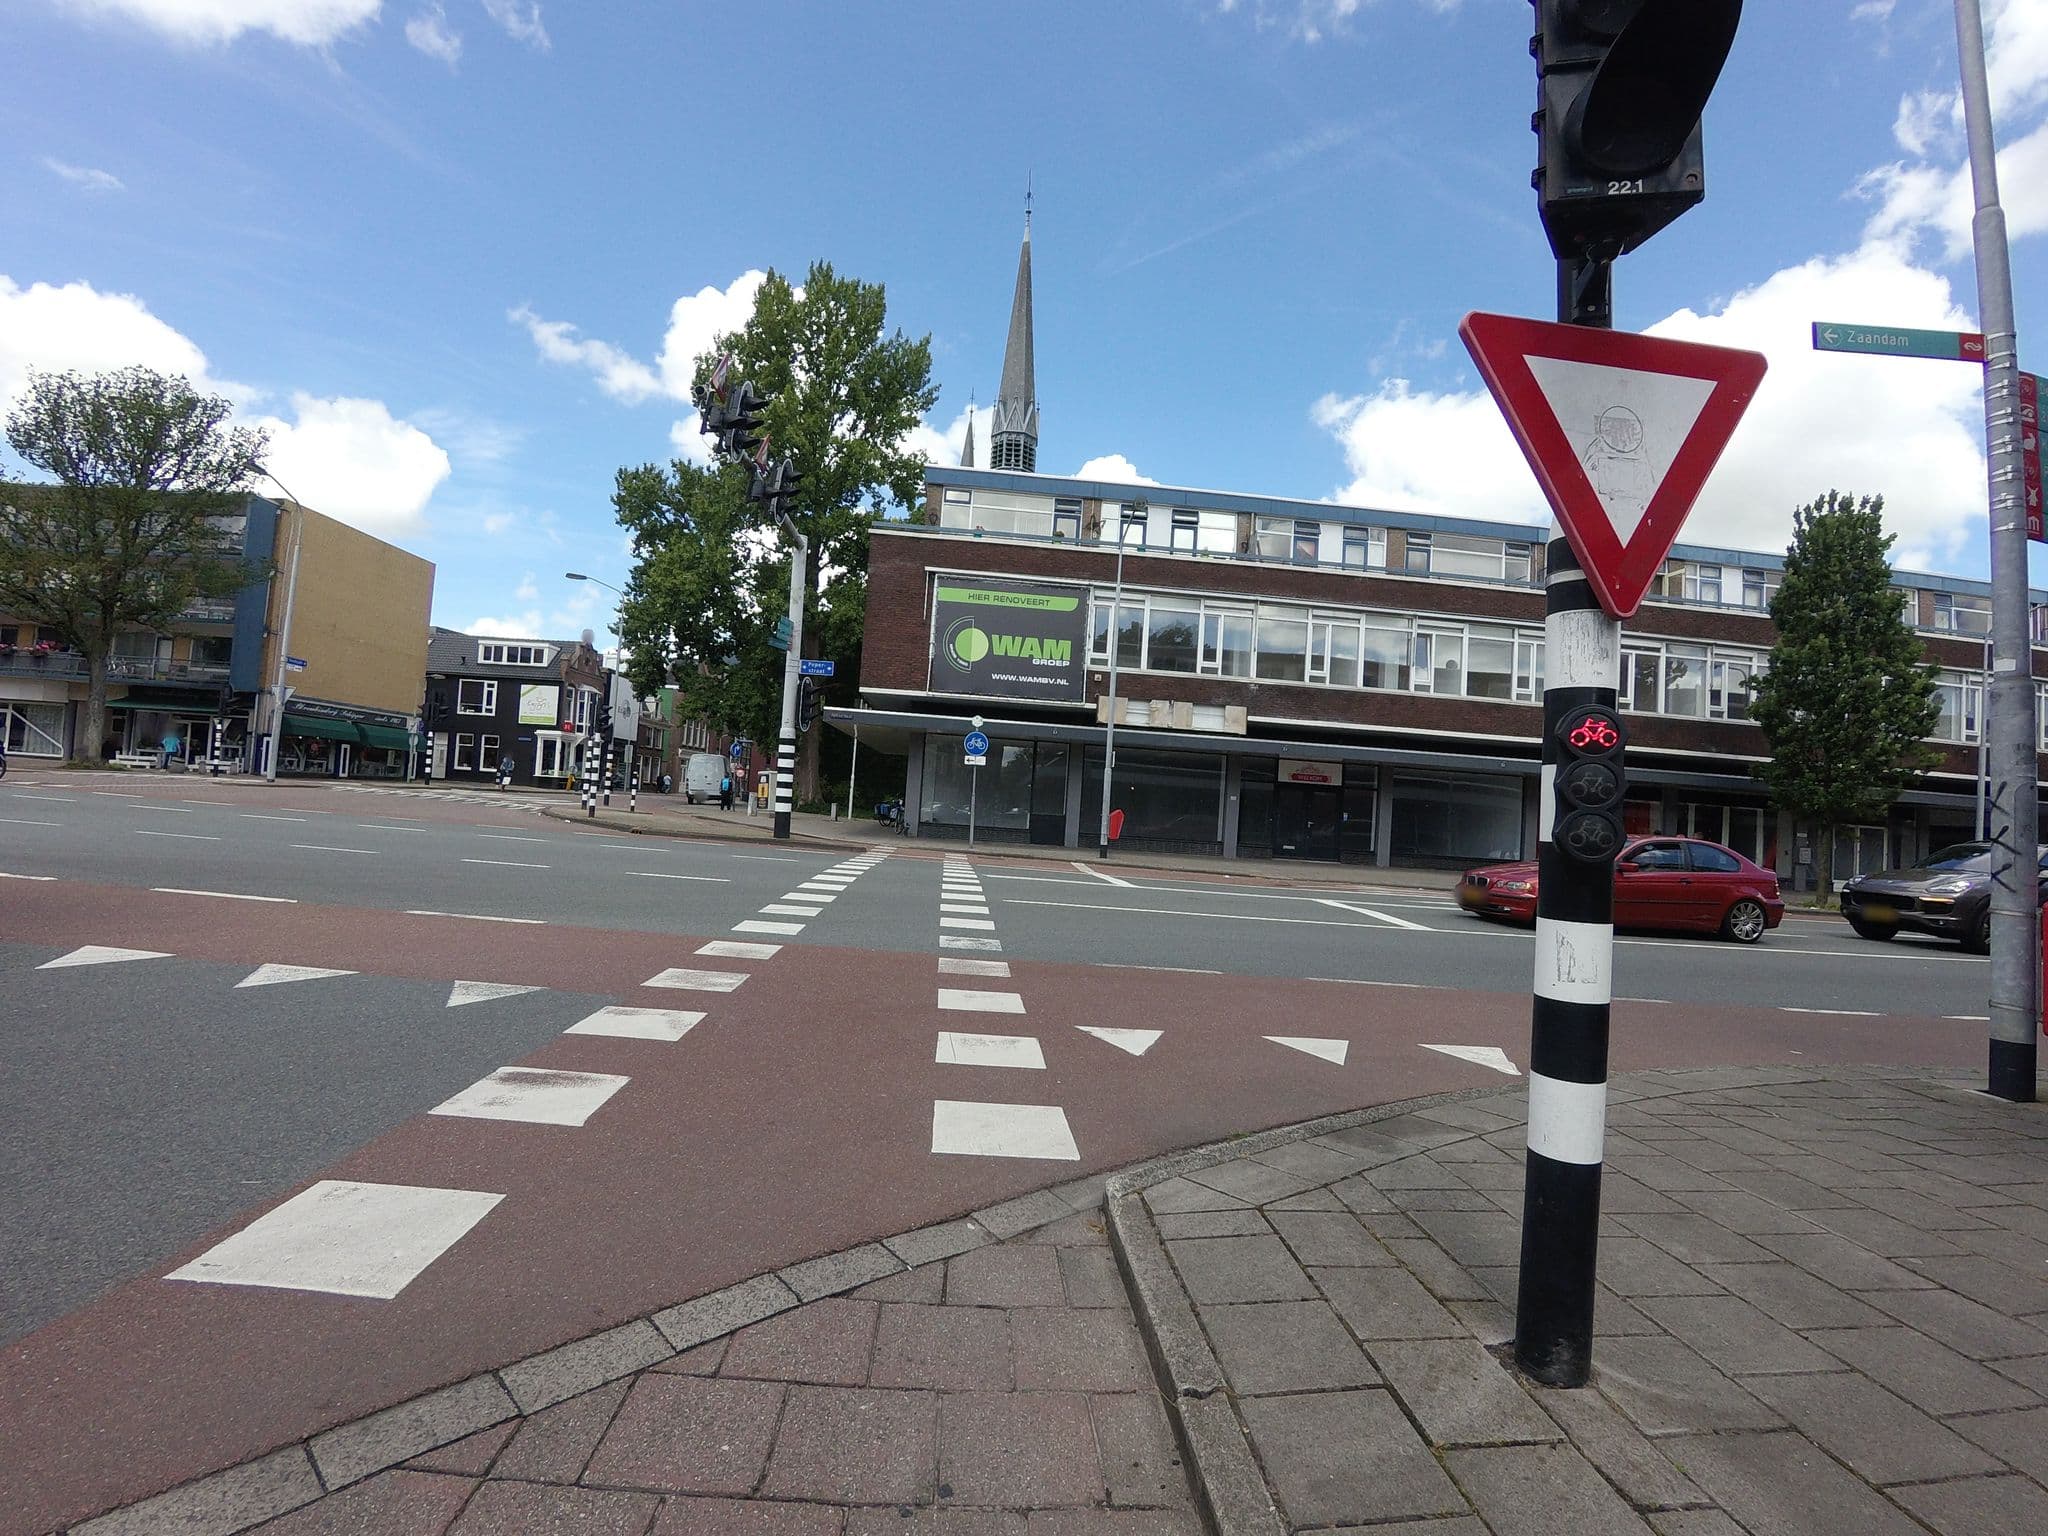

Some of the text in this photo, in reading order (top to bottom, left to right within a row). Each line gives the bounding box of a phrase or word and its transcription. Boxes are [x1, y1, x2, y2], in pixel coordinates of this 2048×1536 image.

[1608, 179, 1643, 195] 22.1
[1847, 330, 1909, 347] Zaandam
[968, 592, 1051, 607] HIER RENOVEERT
[991, 634, 1072, 660] WAM
[1032, 658, 1070, 667] GROEP
[991, 673, 1069, 685] WWW.WAMBV.NL
